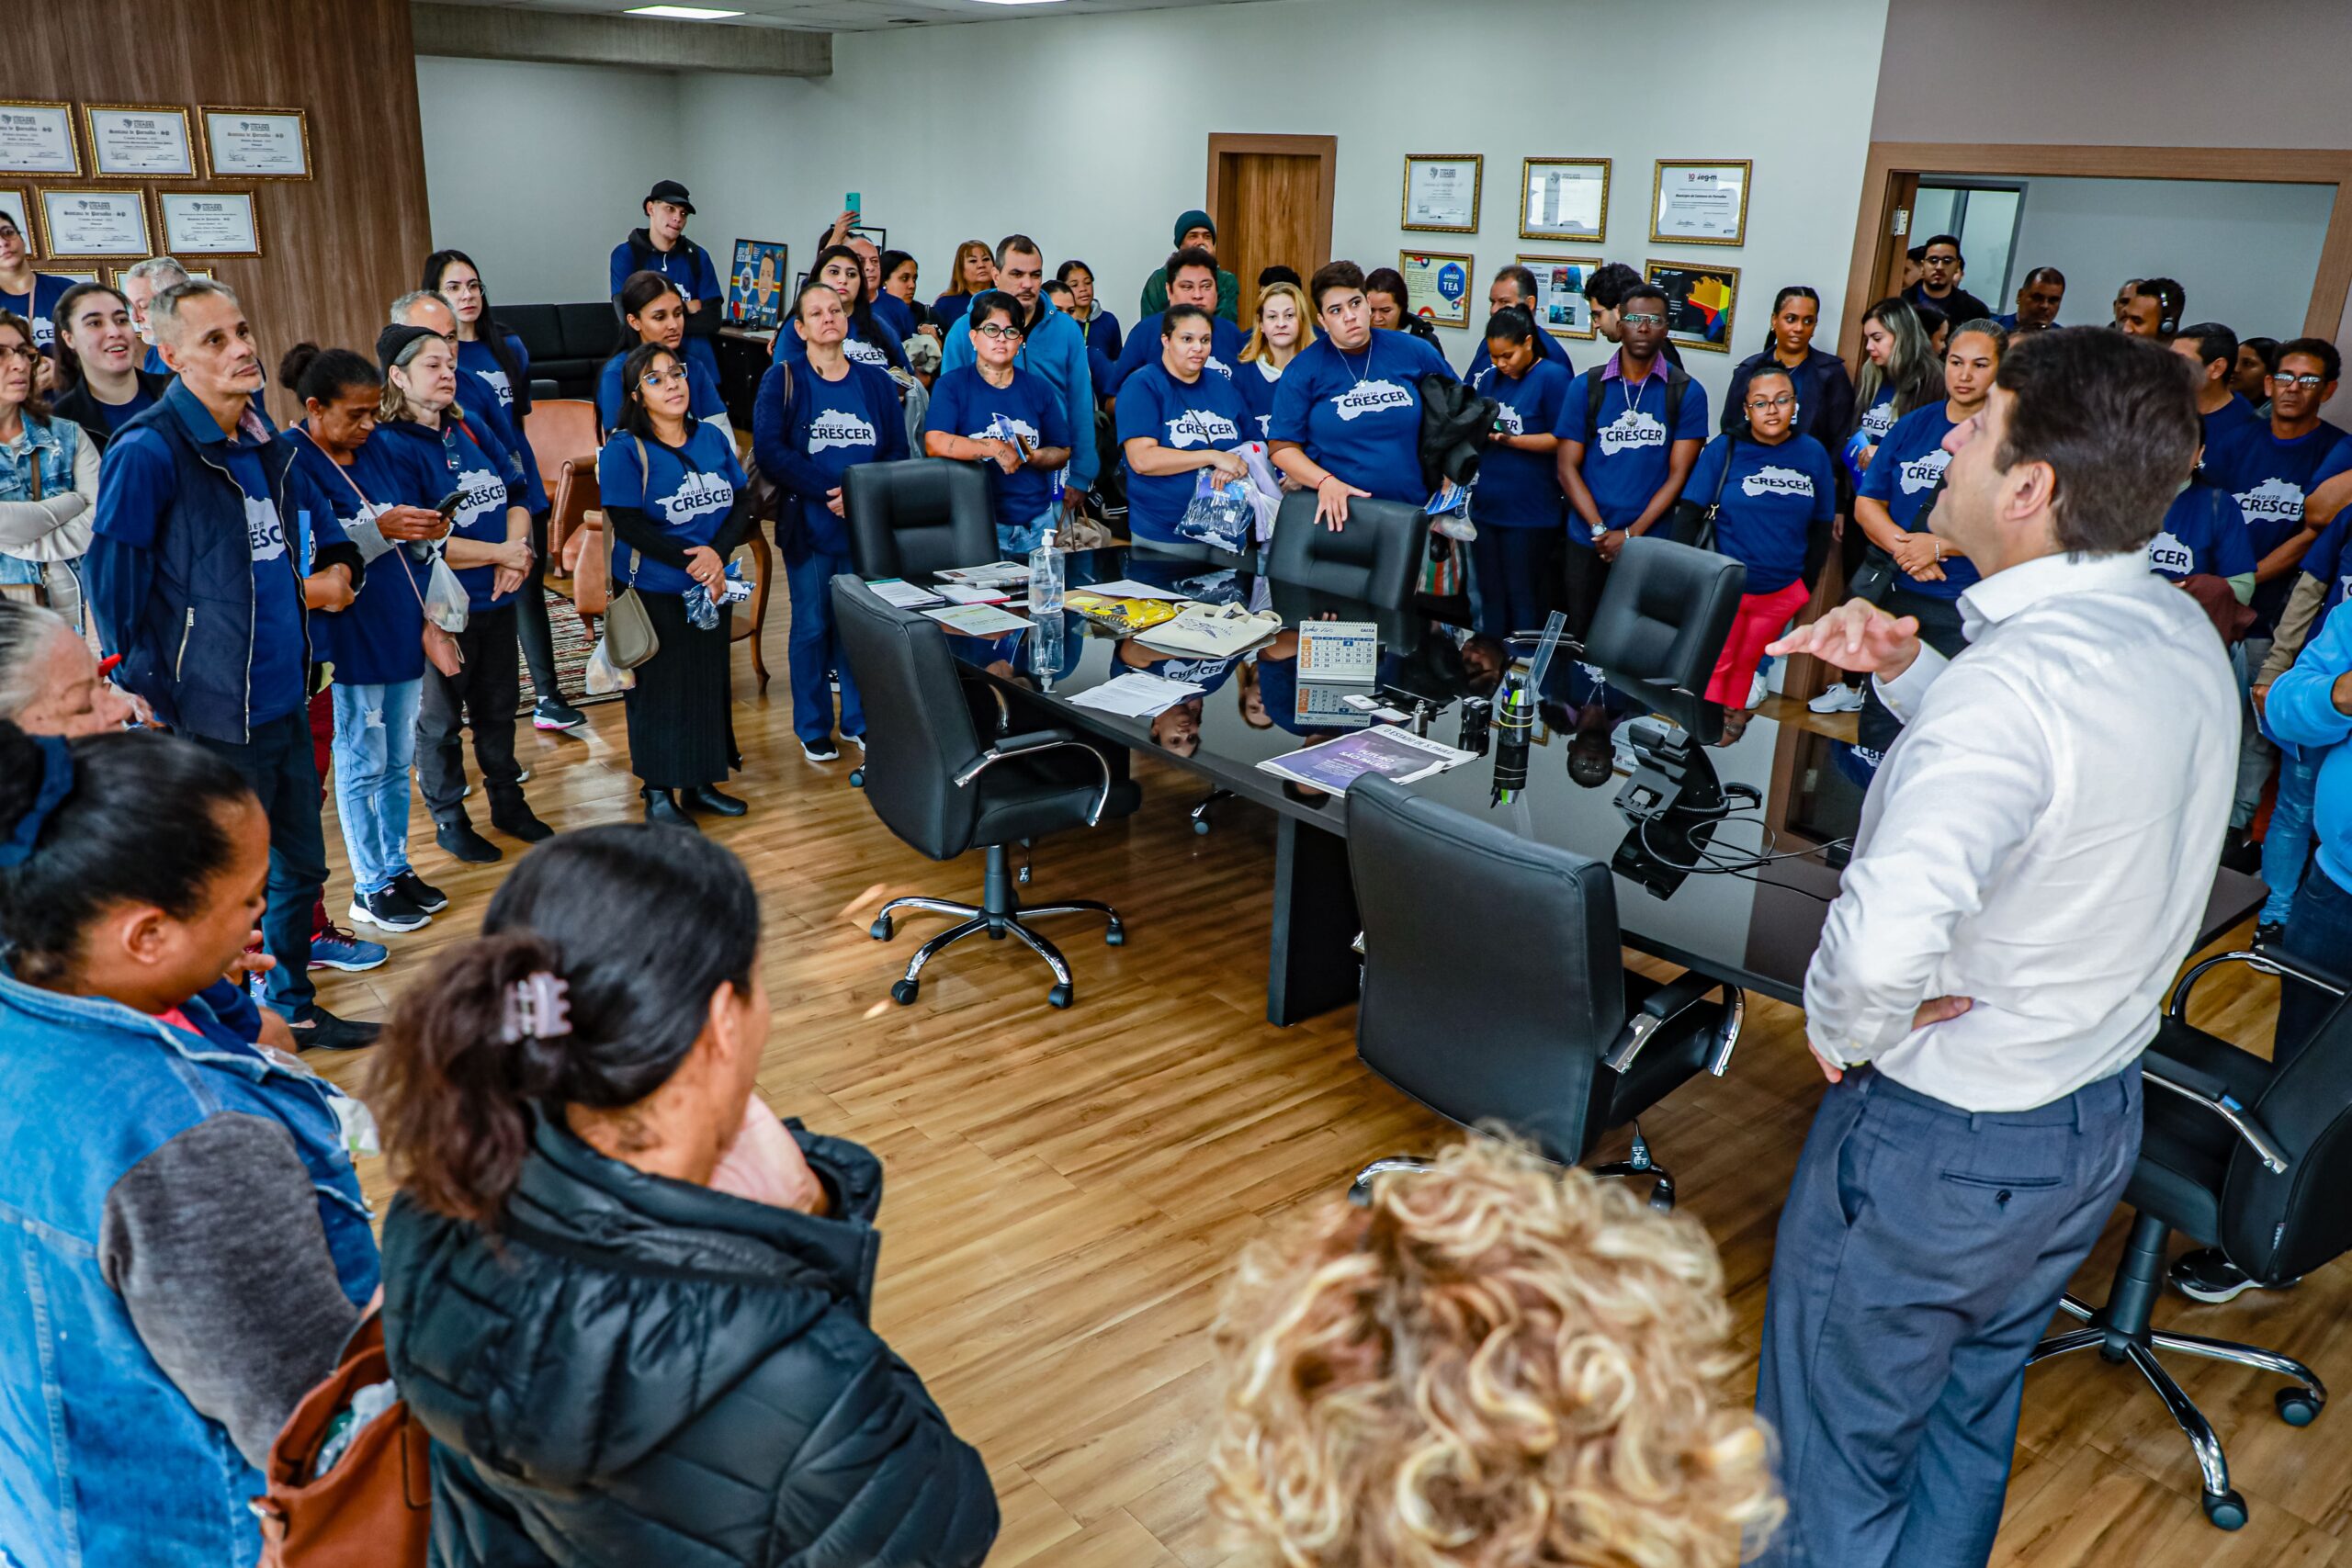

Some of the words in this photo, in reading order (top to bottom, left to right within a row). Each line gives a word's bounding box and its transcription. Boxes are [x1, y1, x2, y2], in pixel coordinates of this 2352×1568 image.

[1443, 282, 1459, 292] TEA
[1343, 391, 1407, 407] CRESCER
[810, 428, 872, 439] CRESCER
[1606, 429, 1663, 441] CRESCER
[672, 488, 732, 512] CRESCER
